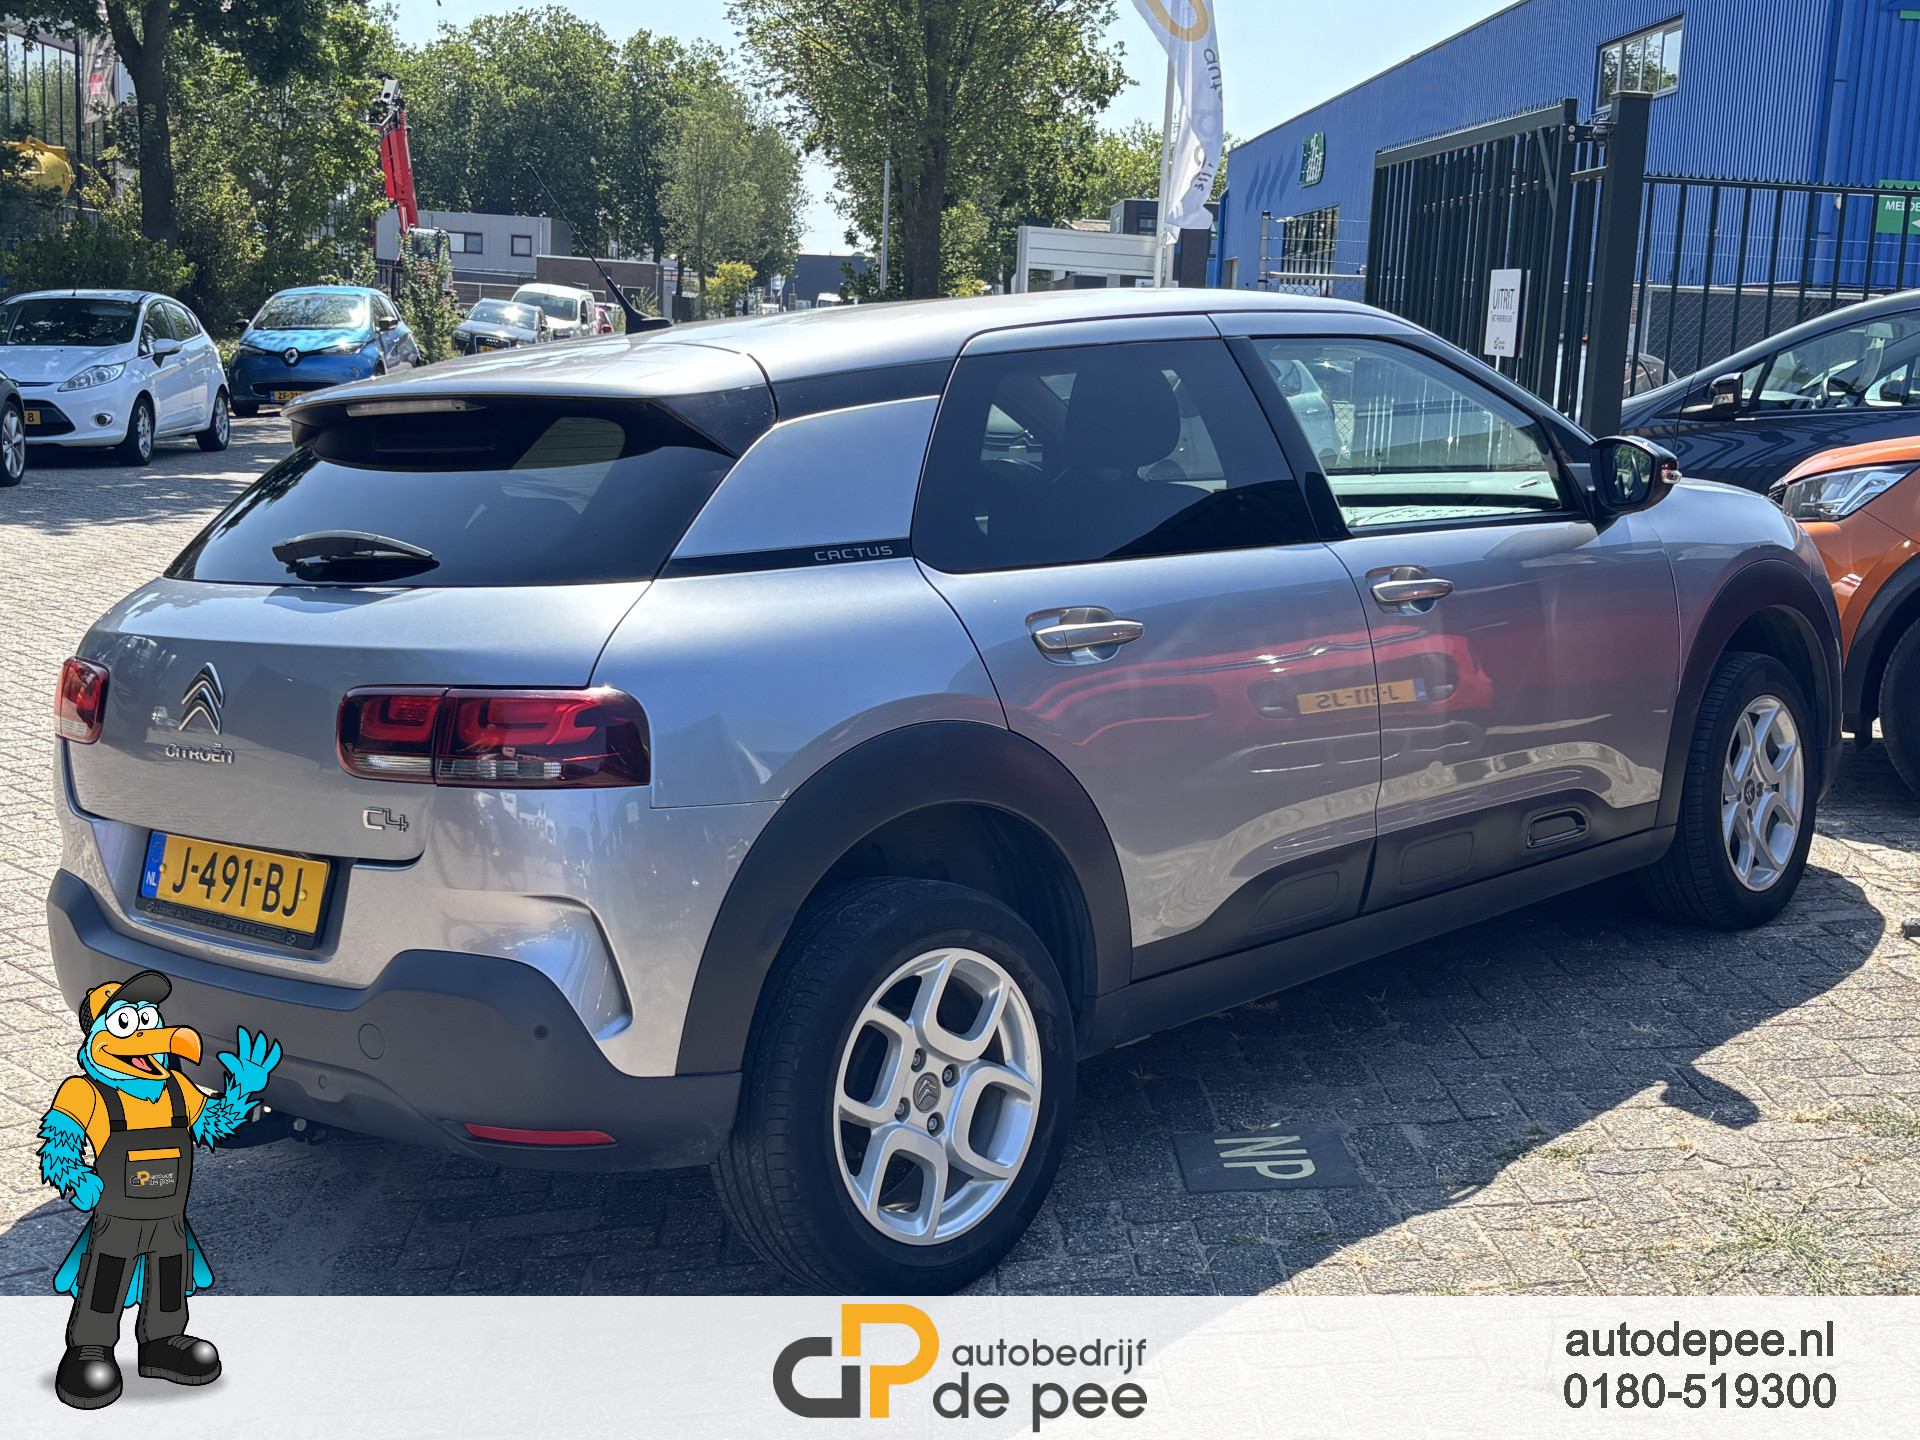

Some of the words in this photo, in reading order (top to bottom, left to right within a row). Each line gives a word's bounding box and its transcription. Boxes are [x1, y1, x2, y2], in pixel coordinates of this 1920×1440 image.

[814, 545, 893, 561] CACTUS
[363, 806, 409, 832] C4
[145, 870, 157, 887] NL
[172, 846, 304, 917] J-491-BJ
[1214, 1135, 1316, 1180] NP
